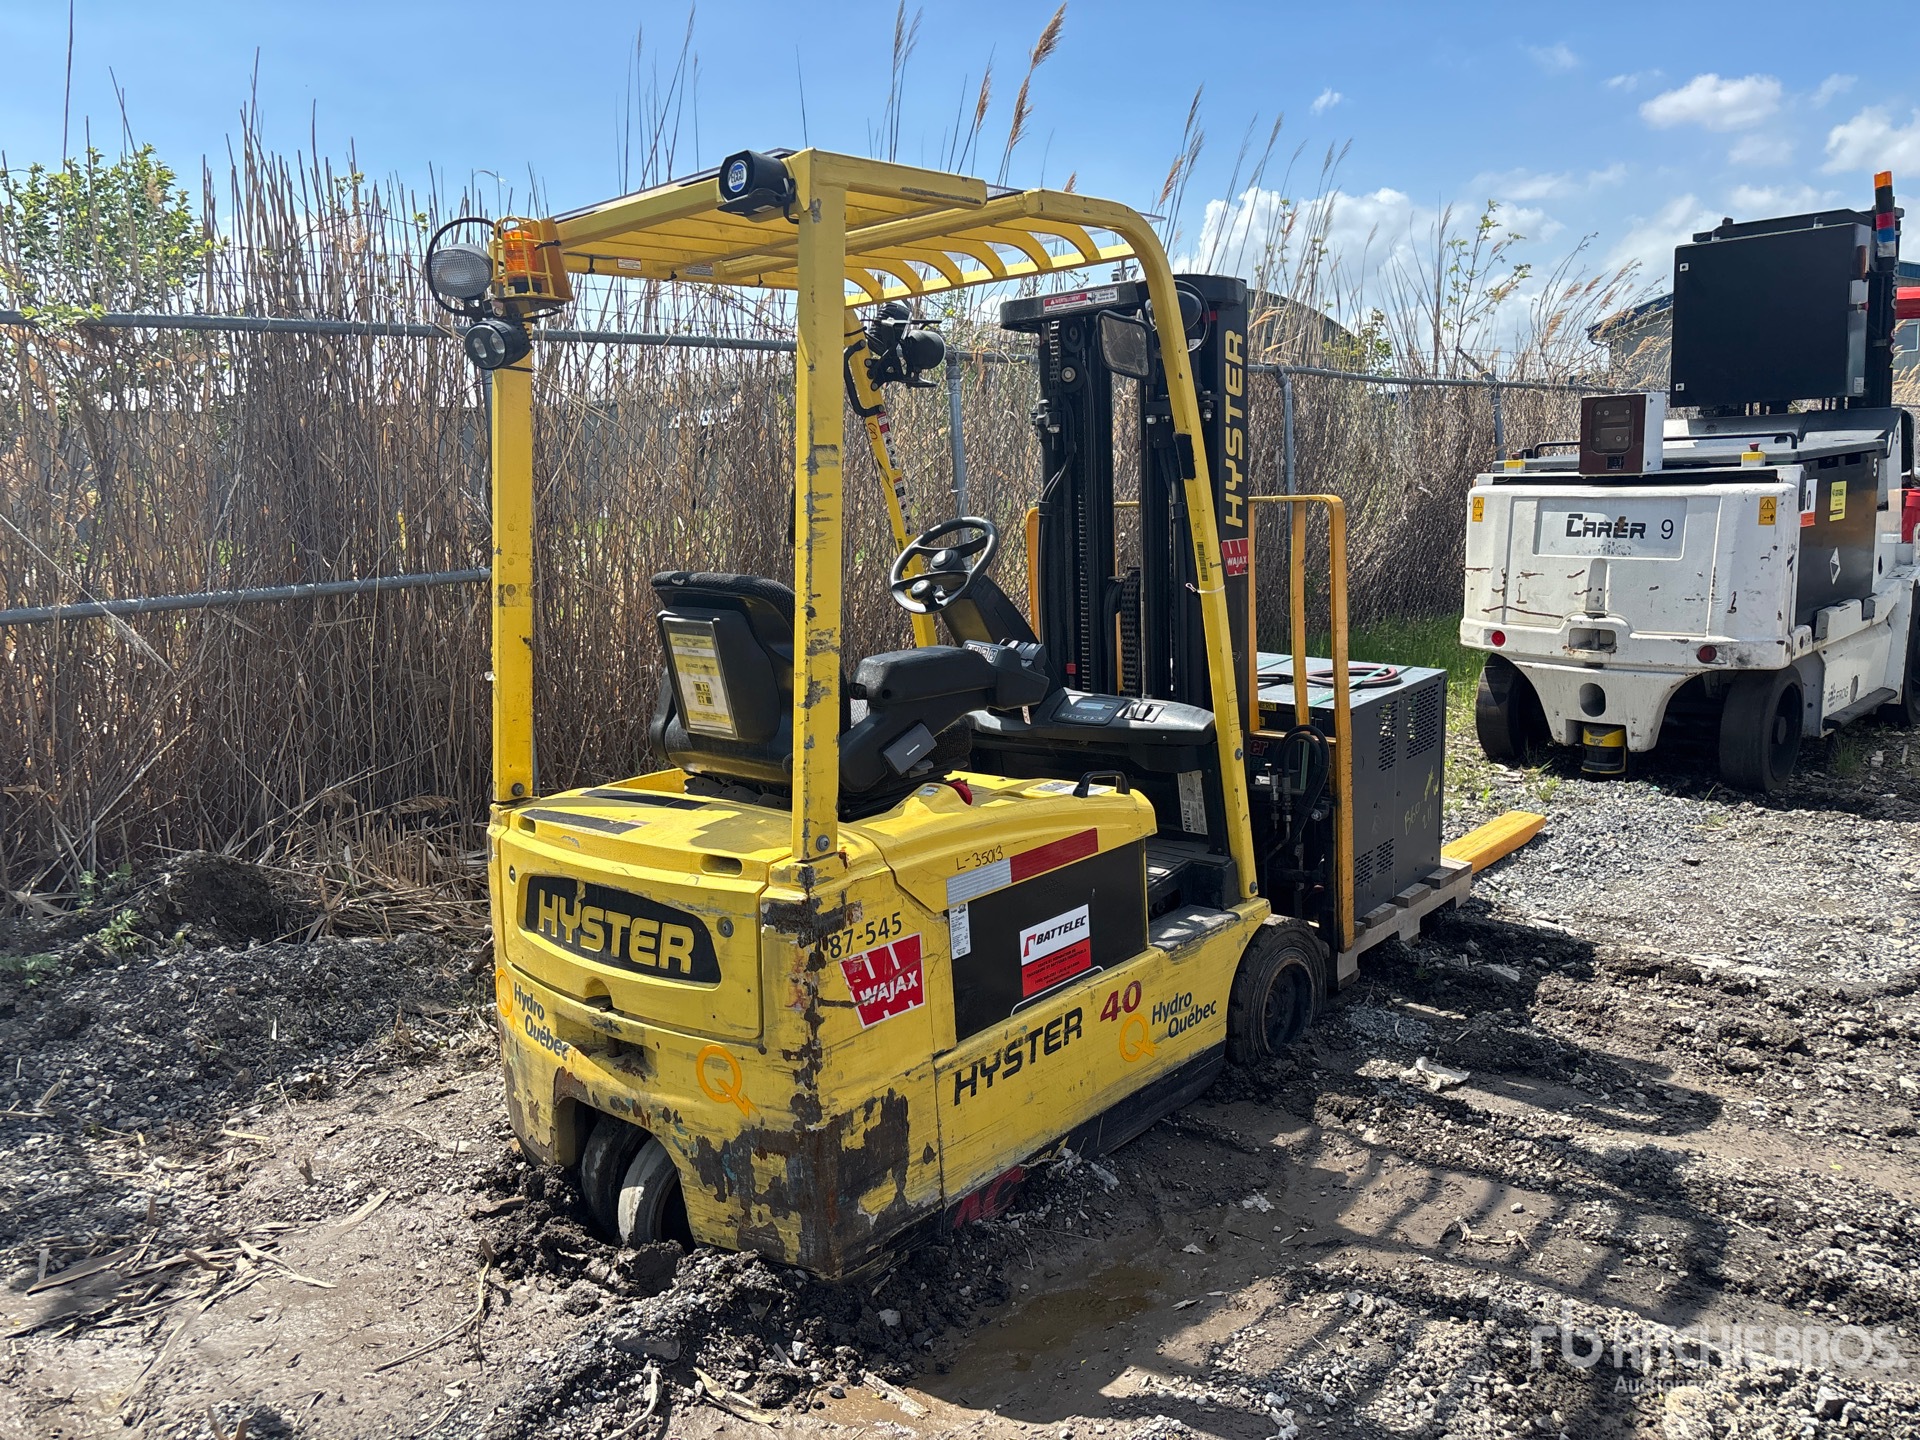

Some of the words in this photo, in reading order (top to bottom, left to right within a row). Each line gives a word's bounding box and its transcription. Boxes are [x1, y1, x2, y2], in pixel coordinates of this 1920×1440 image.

[1225, 329, 1243, 528] HYSTER
[1661, 519, 1674, 540] 9
[1227, 556, 1247, 568] WAJAX
[538, 888, 695, 974] HYSTER
[829, 911, 902, 959] 87-545
[1036, 915, 1087, 945] BATTELEC
[514, 981, 545, 1021] Hydro
[859, 970, 919, 1007] WAJAX
[1100, 980, 1142, 1022] 40
[1151, 991, 1193, 1025] Hydro
[525, 1014, 570, 1061] Québec
[1168, 999, 1217, 1038] Québec
[954, 1006, 1083, 1106] HYSTER
